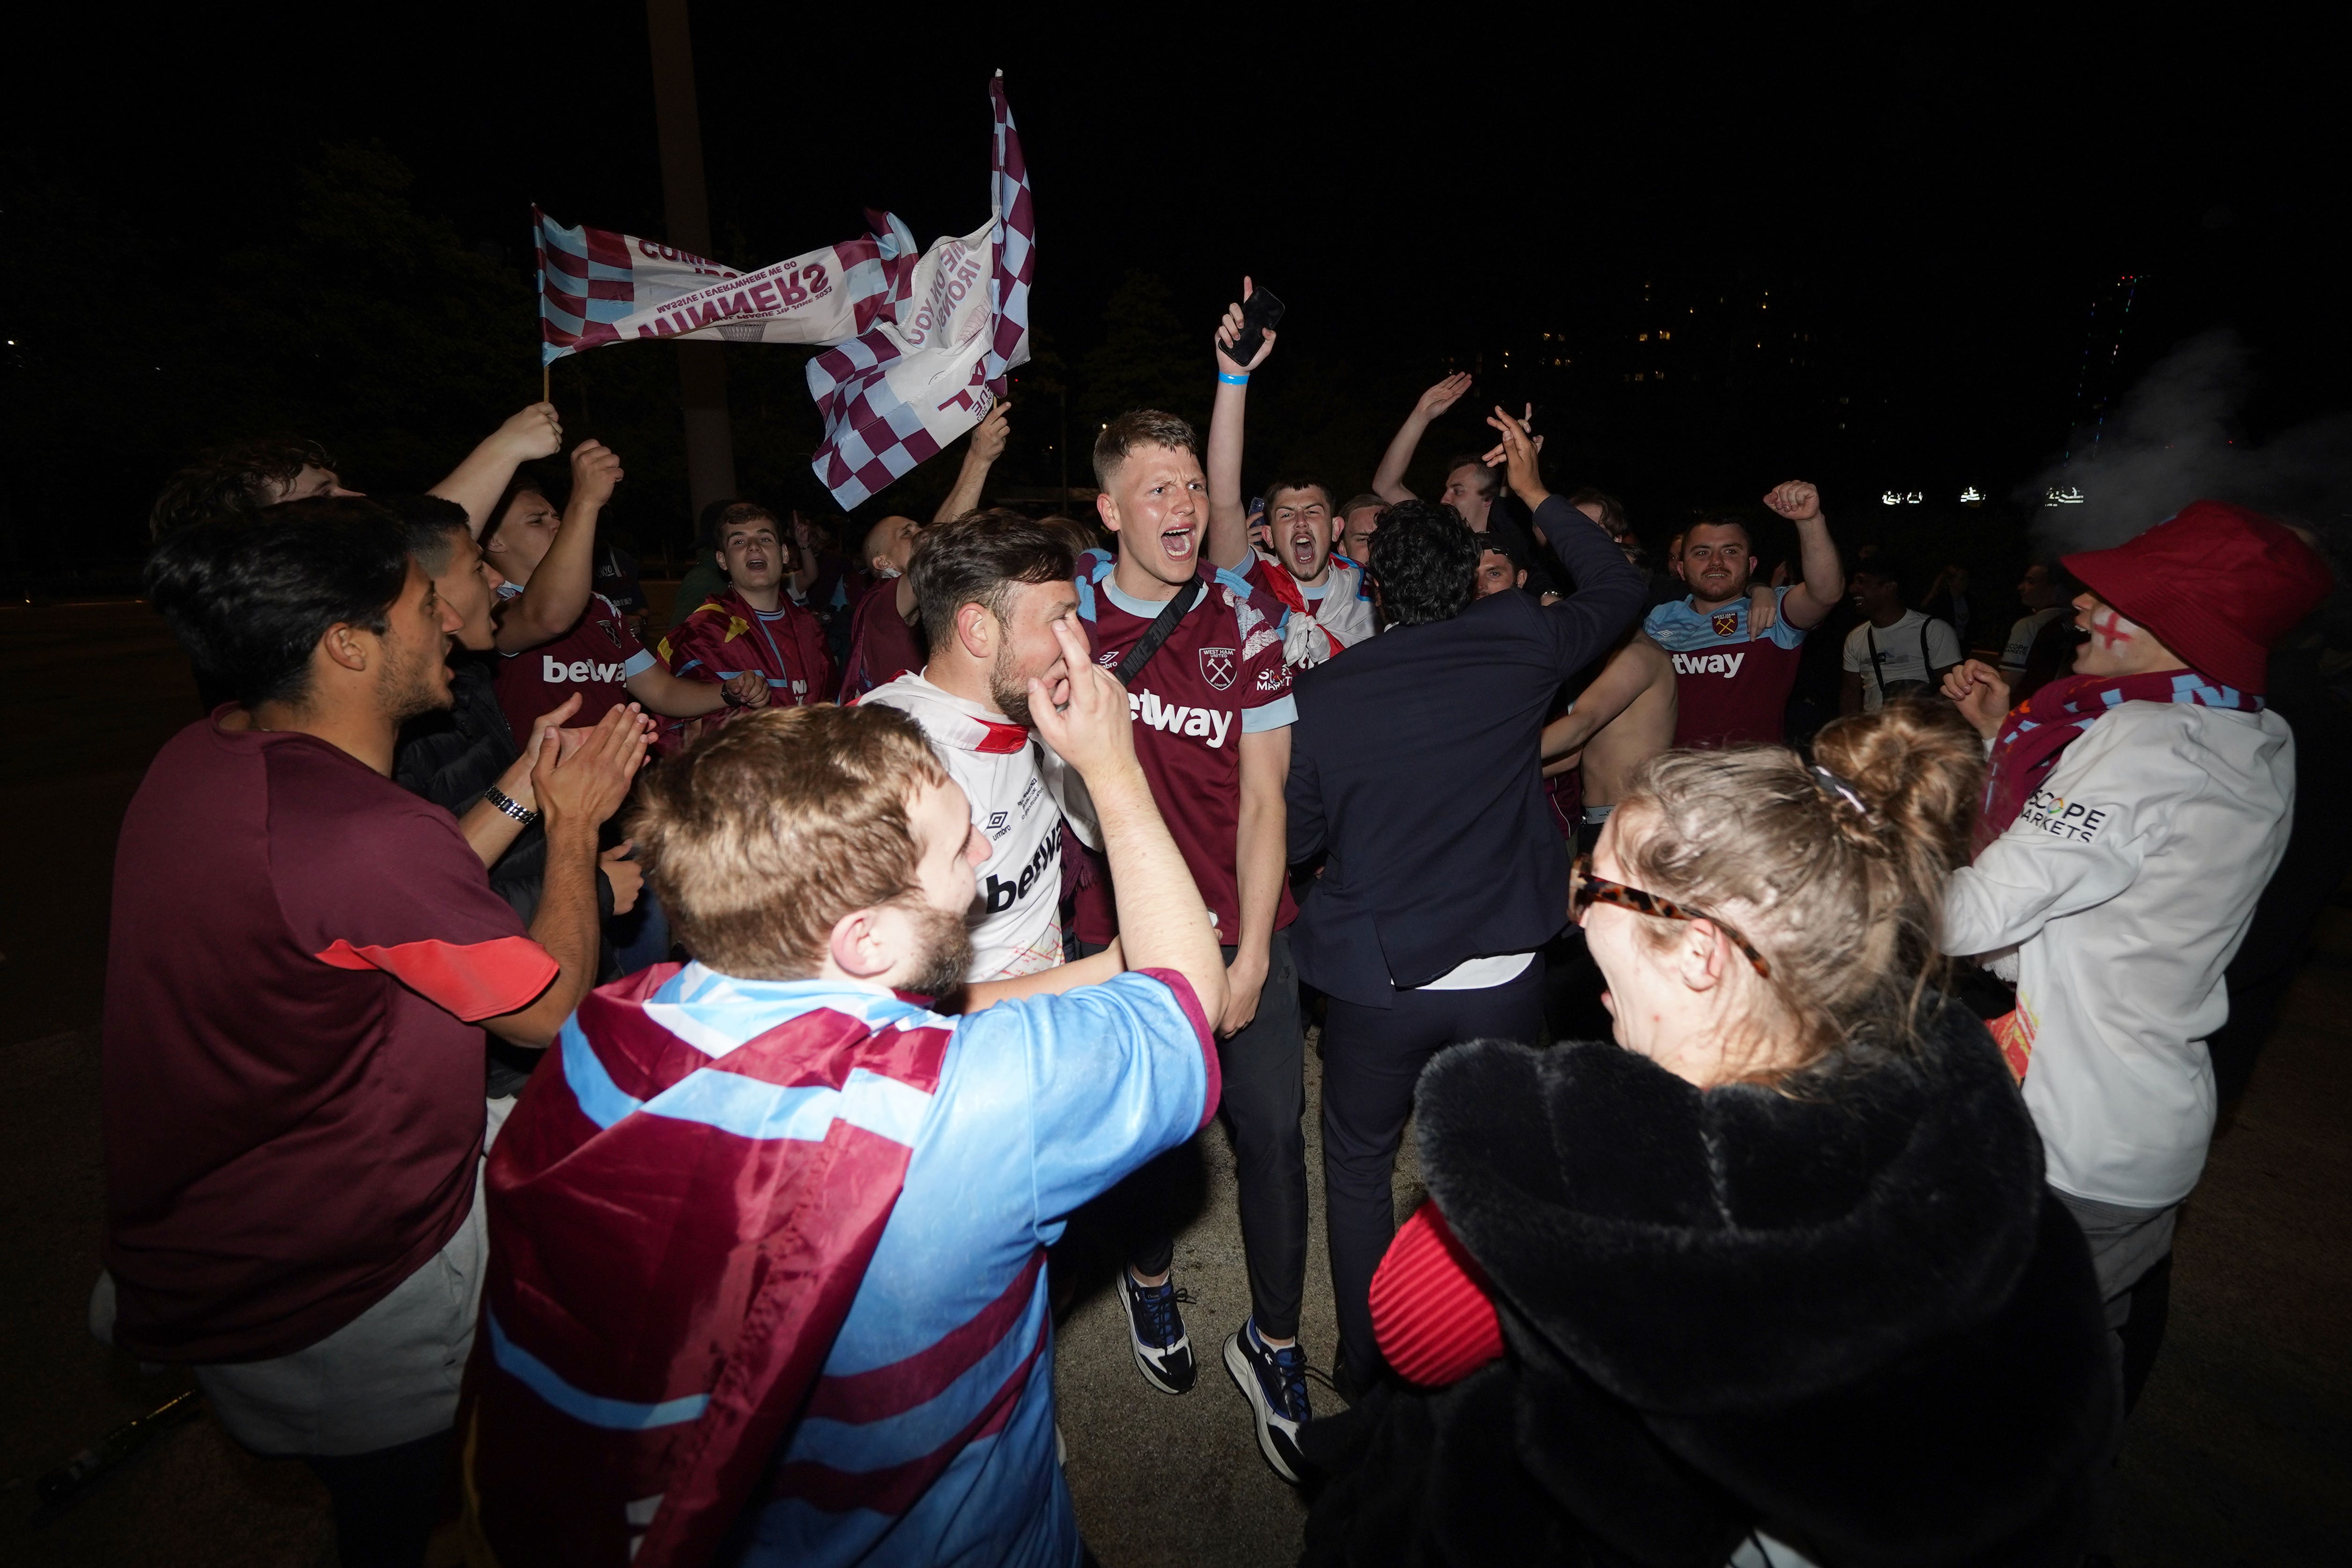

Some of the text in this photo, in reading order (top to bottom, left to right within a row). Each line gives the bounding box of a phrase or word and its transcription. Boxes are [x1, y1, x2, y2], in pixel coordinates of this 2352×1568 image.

[976, 406, 988, 422] 2023
[543, 655, 627, 688] betwa
[1672, 652, 1745, 678] tway
[1127, 688, 1233, 748] etway
[2028, 789, 2107, 831] SCOPE
[992, 824, 1011, 841] umbro
[985, 818, 1062, 914] betwa
